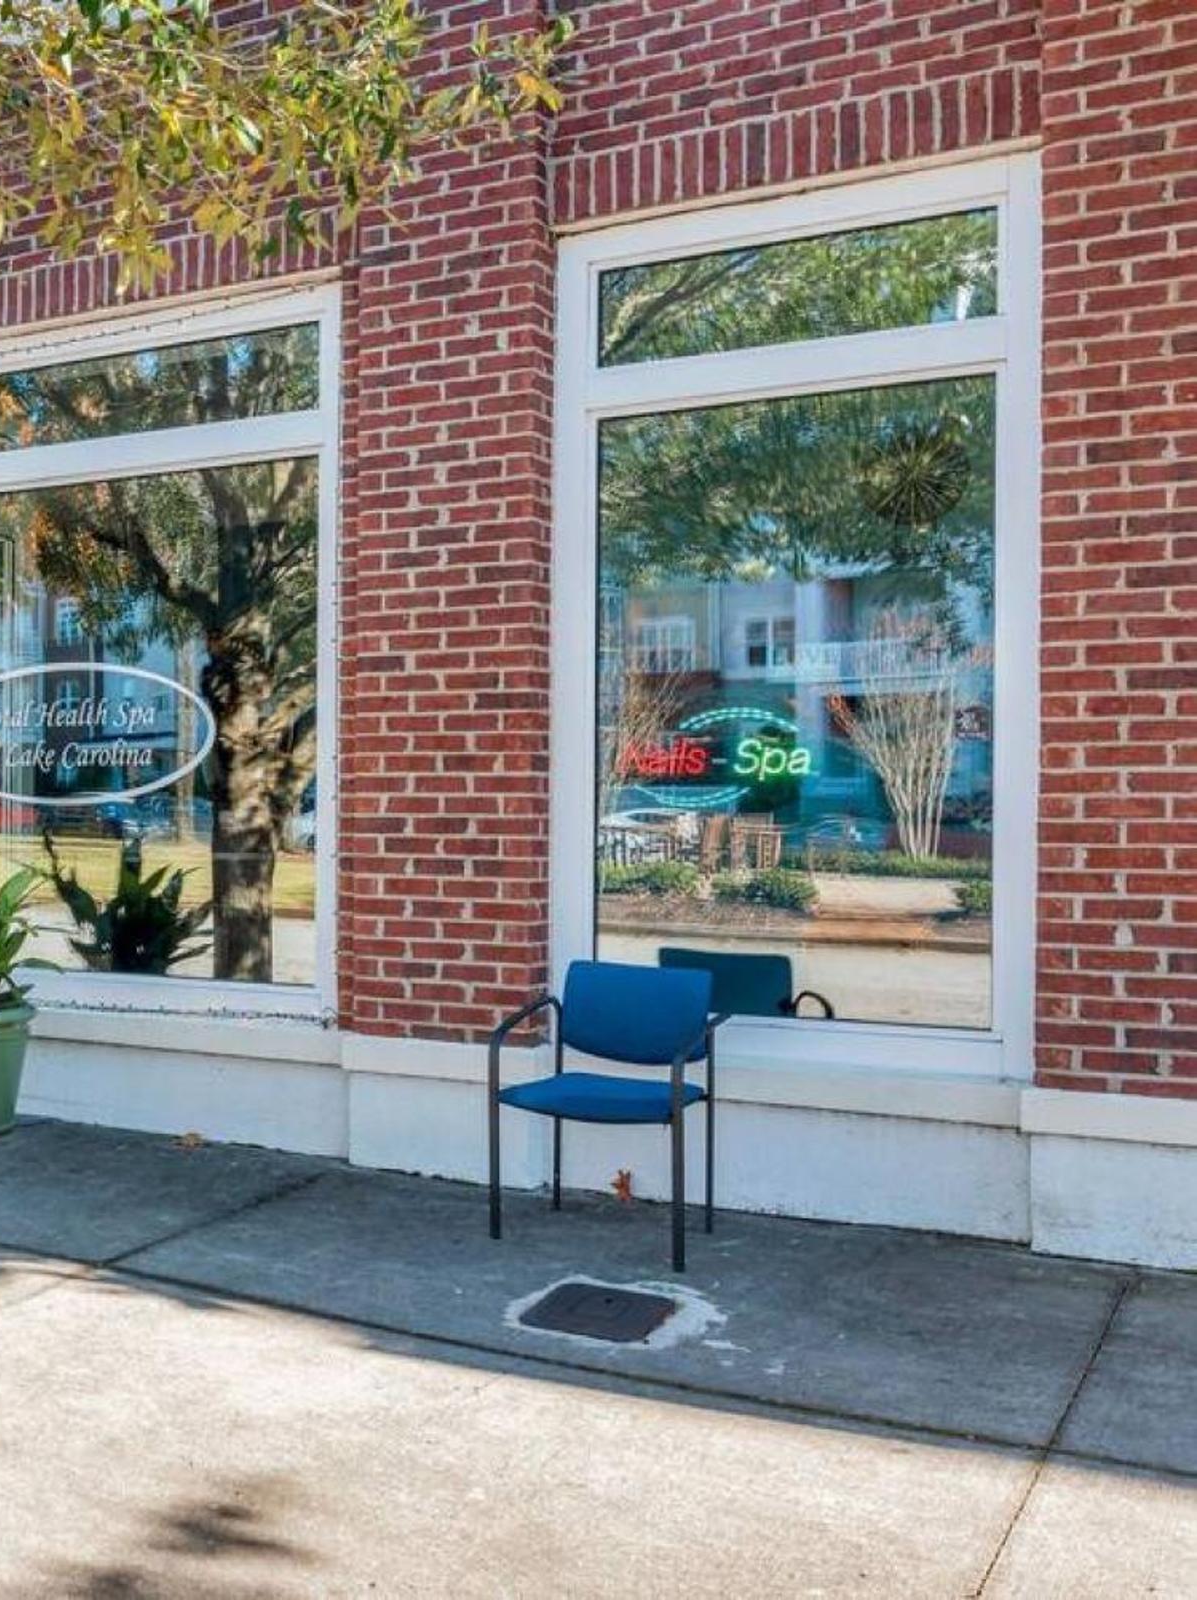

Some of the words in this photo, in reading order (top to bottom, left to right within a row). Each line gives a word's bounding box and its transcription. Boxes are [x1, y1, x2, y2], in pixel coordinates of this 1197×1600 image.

[34, 696, 109, 728] Health
[112, 701, 156, 734] Spa
[5, 738, 57, 774] Lake
[61, 738, 155, 770] Carolina
[615, 736, 710, 778] Nails
[732, 738, 812, 782] Spa
